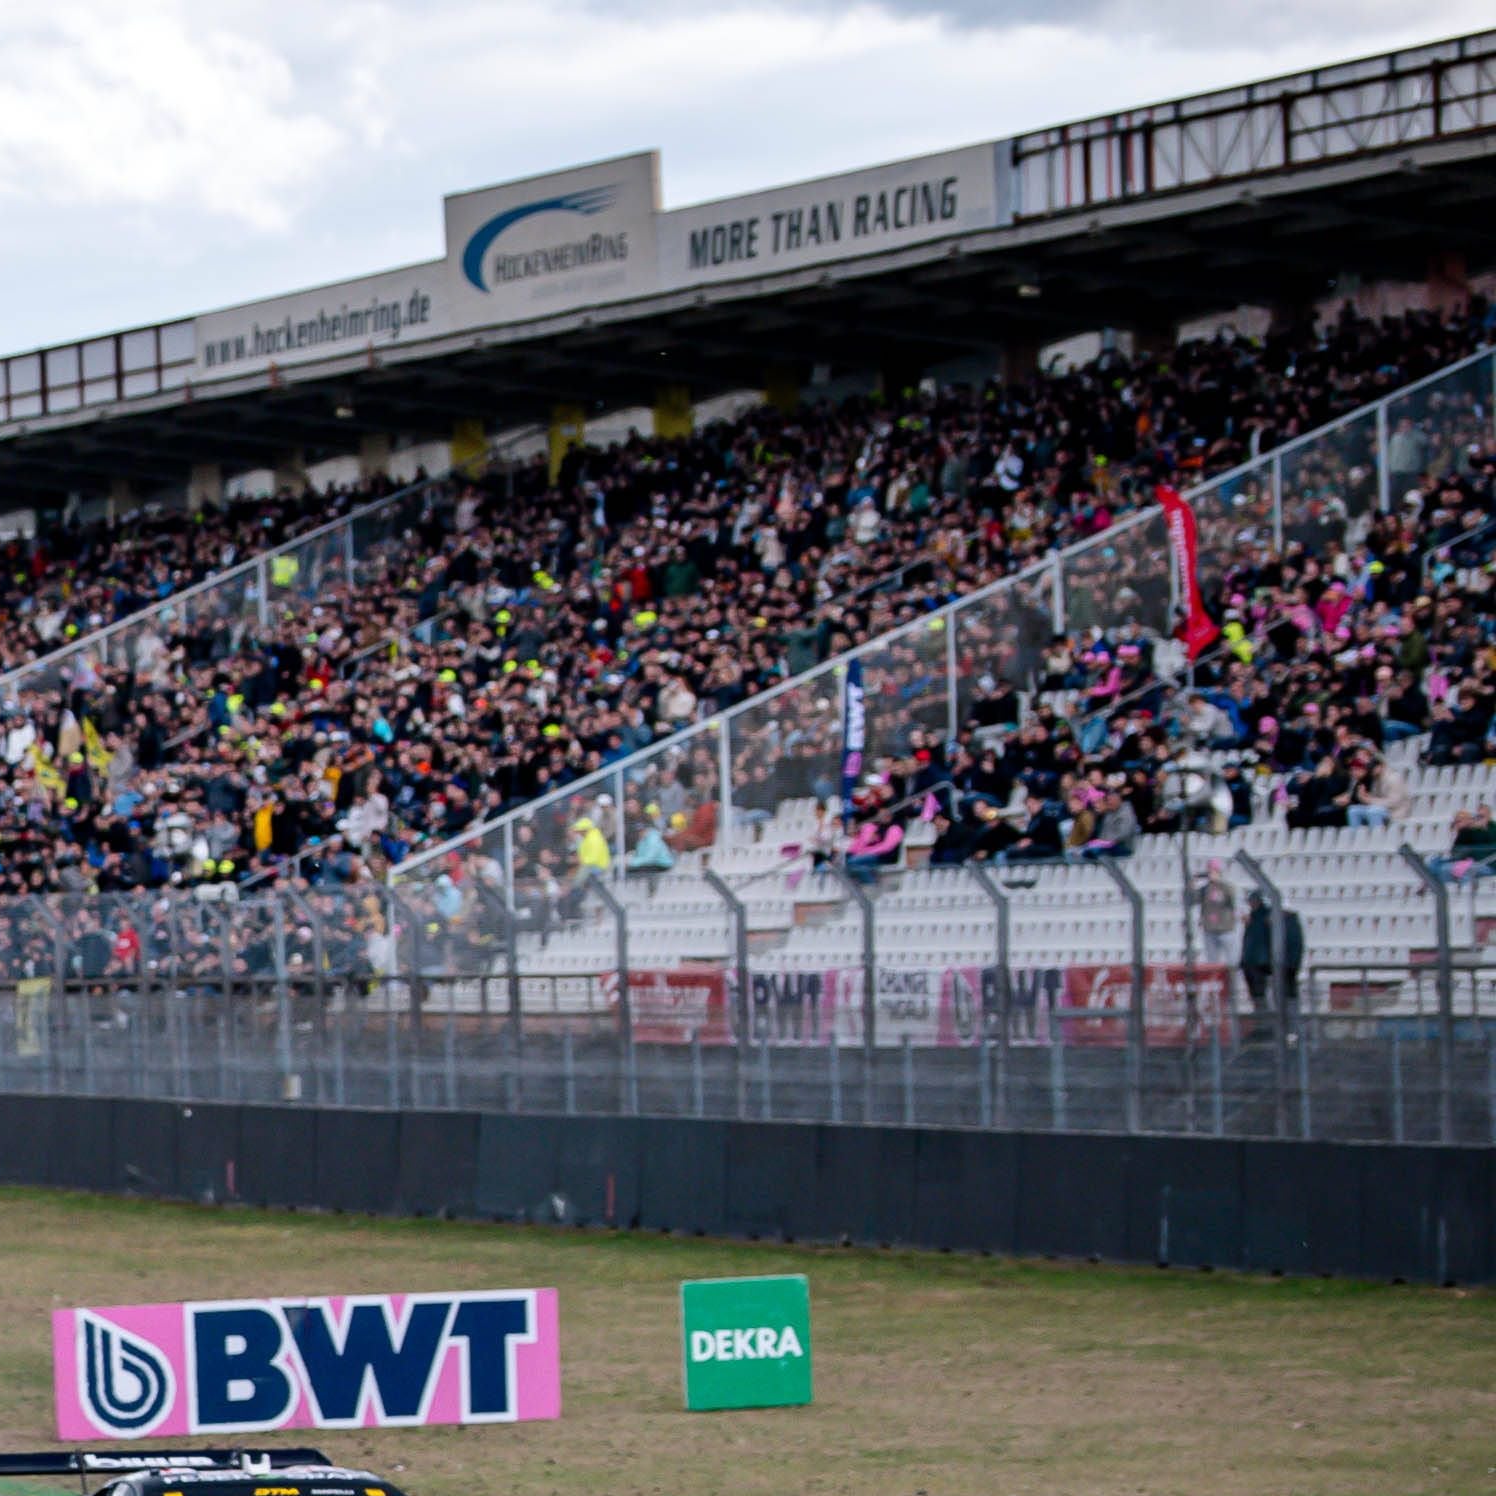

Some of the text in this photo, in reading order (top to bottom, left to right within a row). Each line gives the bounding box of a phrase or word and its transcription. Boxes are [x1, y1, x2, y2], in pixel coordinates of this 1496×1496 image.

[688, 175, 959, 269] MORE THAN RACING
[204, 289, 431, 369] www.hockenheimring.de
[190, 1295, 534, 1428] BWT
[690, 1326, 804, 1362] DEKRA
